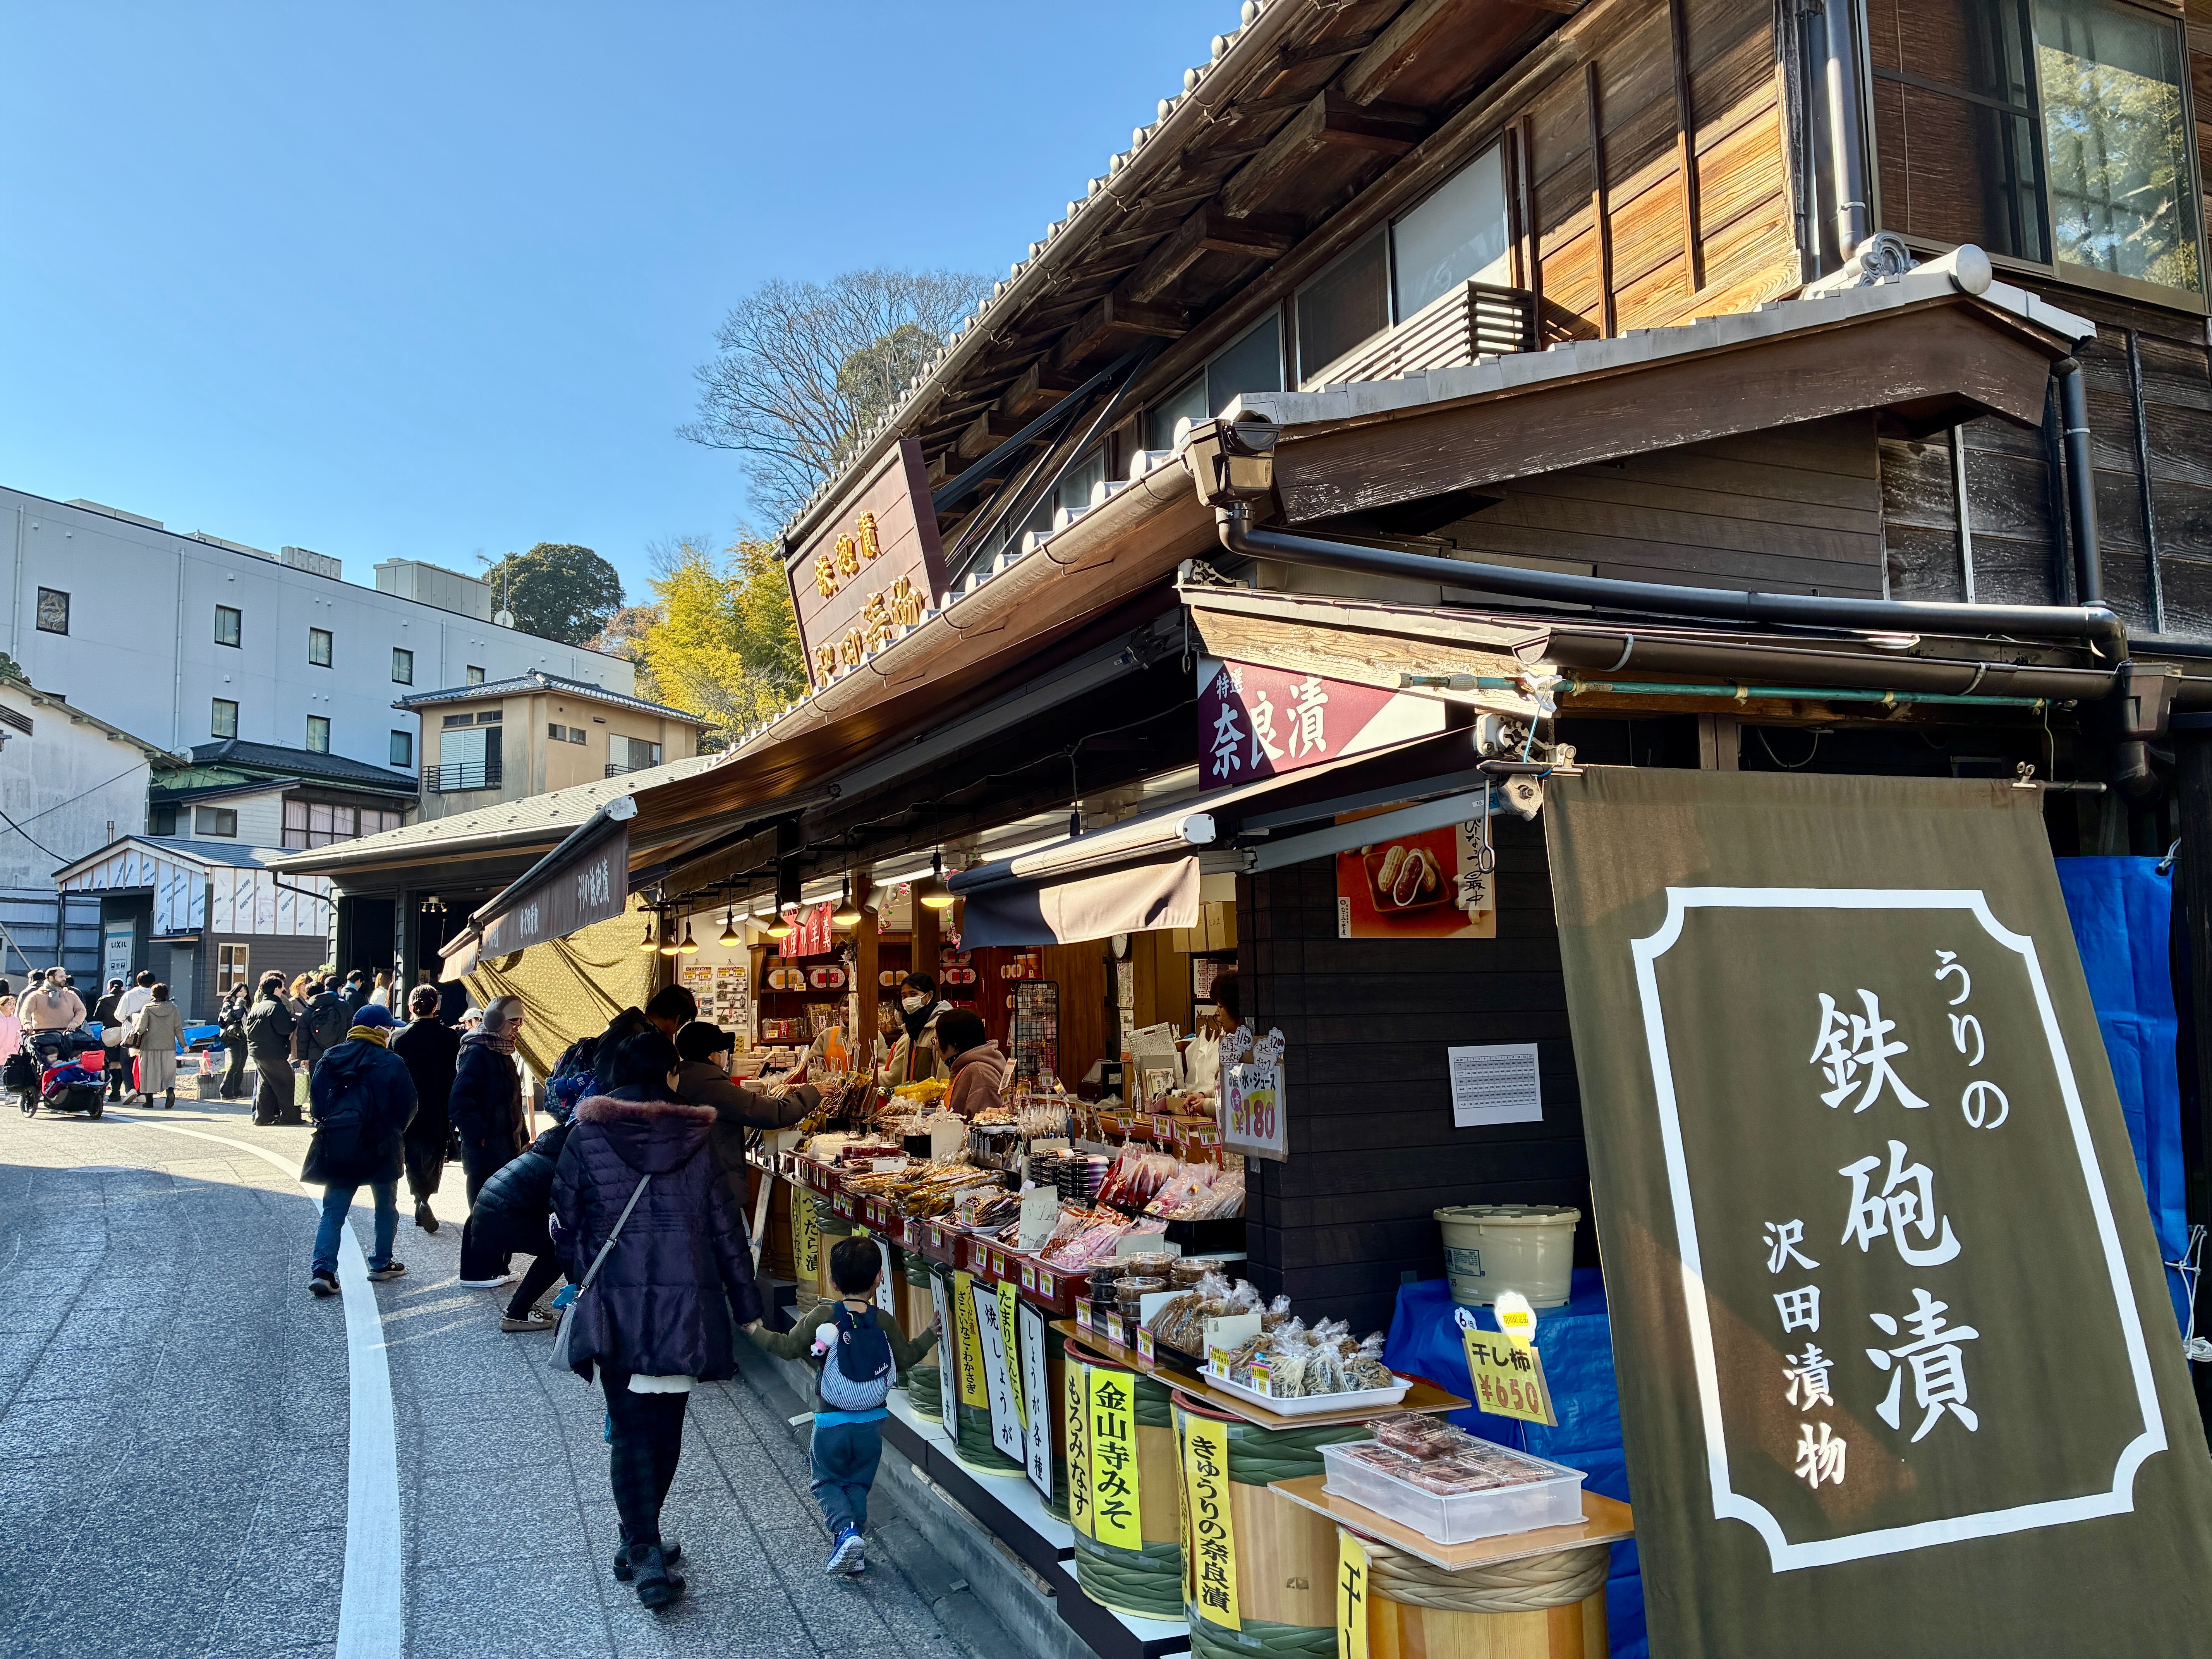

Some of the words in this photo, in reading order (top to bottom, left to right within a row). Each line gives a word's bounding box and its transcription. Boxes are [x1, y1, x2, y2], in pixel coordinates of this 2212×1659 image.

[1209, 676, 1329, 779] 奈良漬
[1216, 666, 1245, 700] 特選
[111, 941, 127, 949] LIXIL
[1934, 950, 2009, 1129] うりの
[1809, 989, 1980, 1443] 鉄砲漬
[1472, 1343, 1531, 1372] 干し柿
[1503, 1314, 1529, 1324] 期間限定品
[1762, 1218, 1847, 1489] 沢田漬物
[1027, 1319, 1043, 1482] しょうが各種
[1068, 1376, 1089, 1516] もろみなす
[1095, 1381, 1132, 1529] 金山寺みそ
[1478, 1373, 1540, 1414] ¥650
[1192, 1436, 1230, 1614] きゅうりの奈良漬
